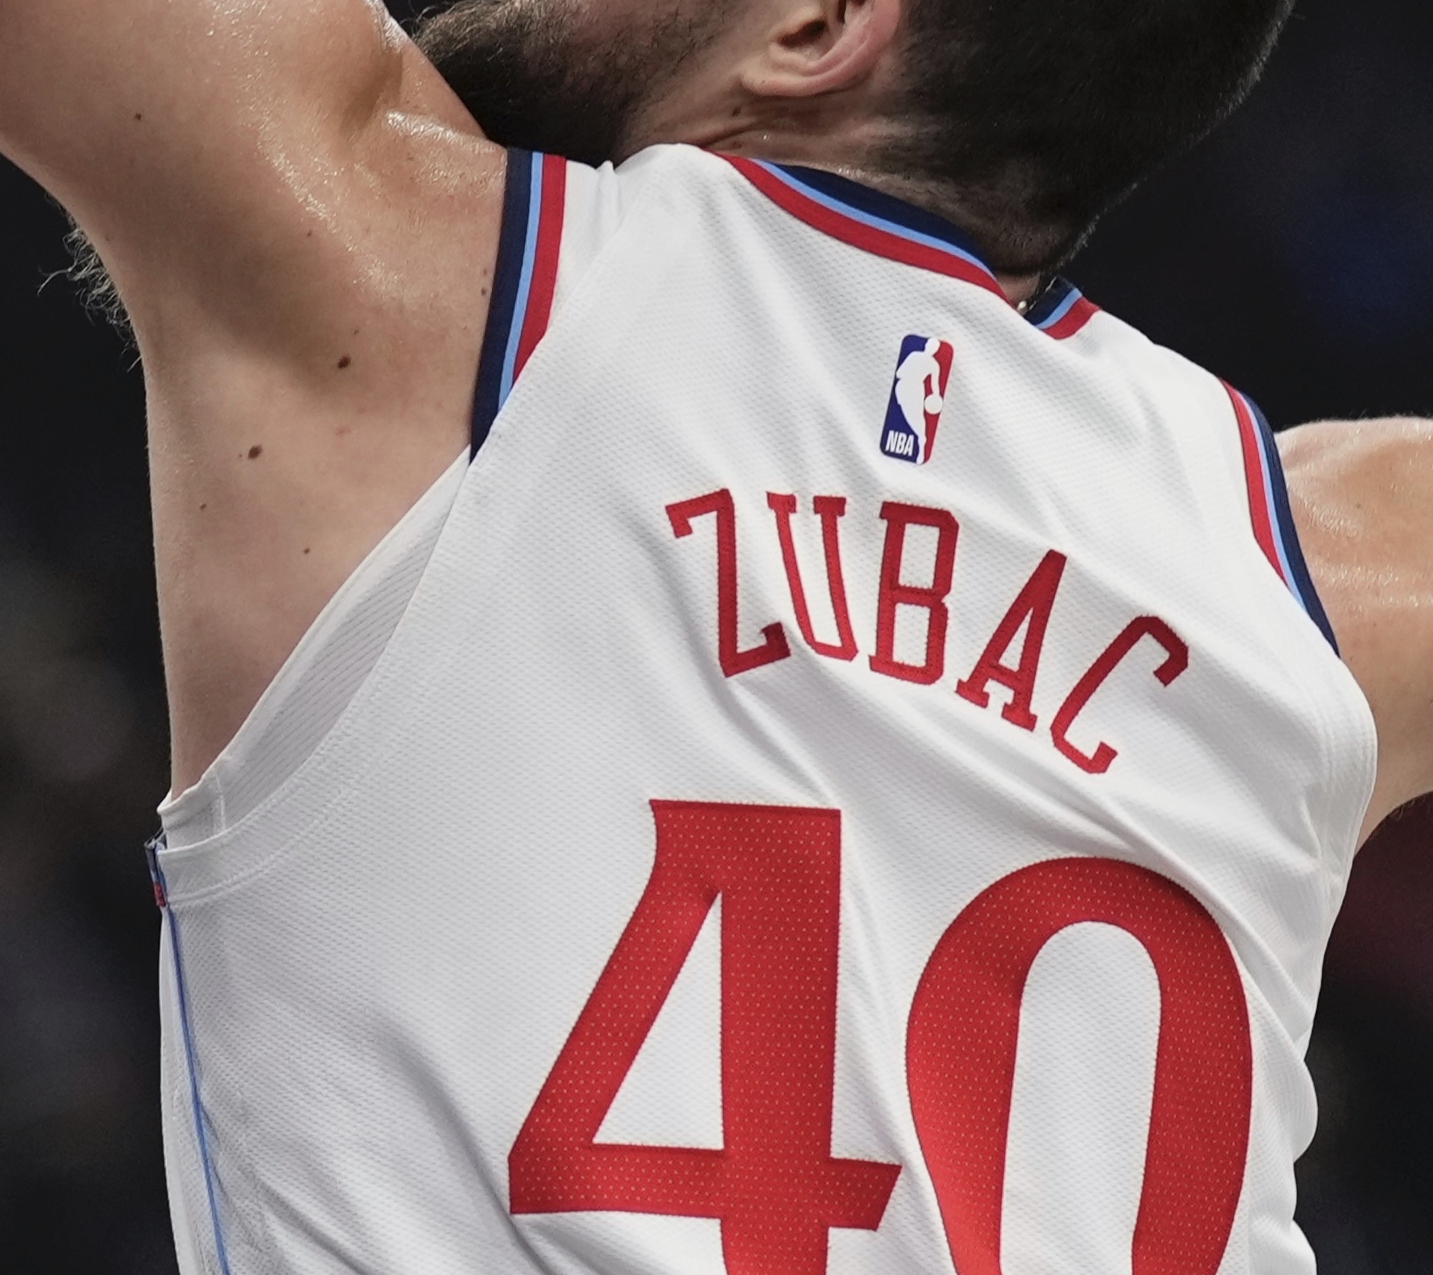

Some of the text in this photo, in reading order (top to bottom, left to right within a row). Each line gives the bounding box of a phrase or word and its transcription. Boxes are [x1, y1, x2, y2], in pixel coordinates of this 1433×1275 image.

[885, 430, 915, 457] NBA
[664, 487, 1190, 776] ZUBAC
[507, 798, 1254, 1275] 40
